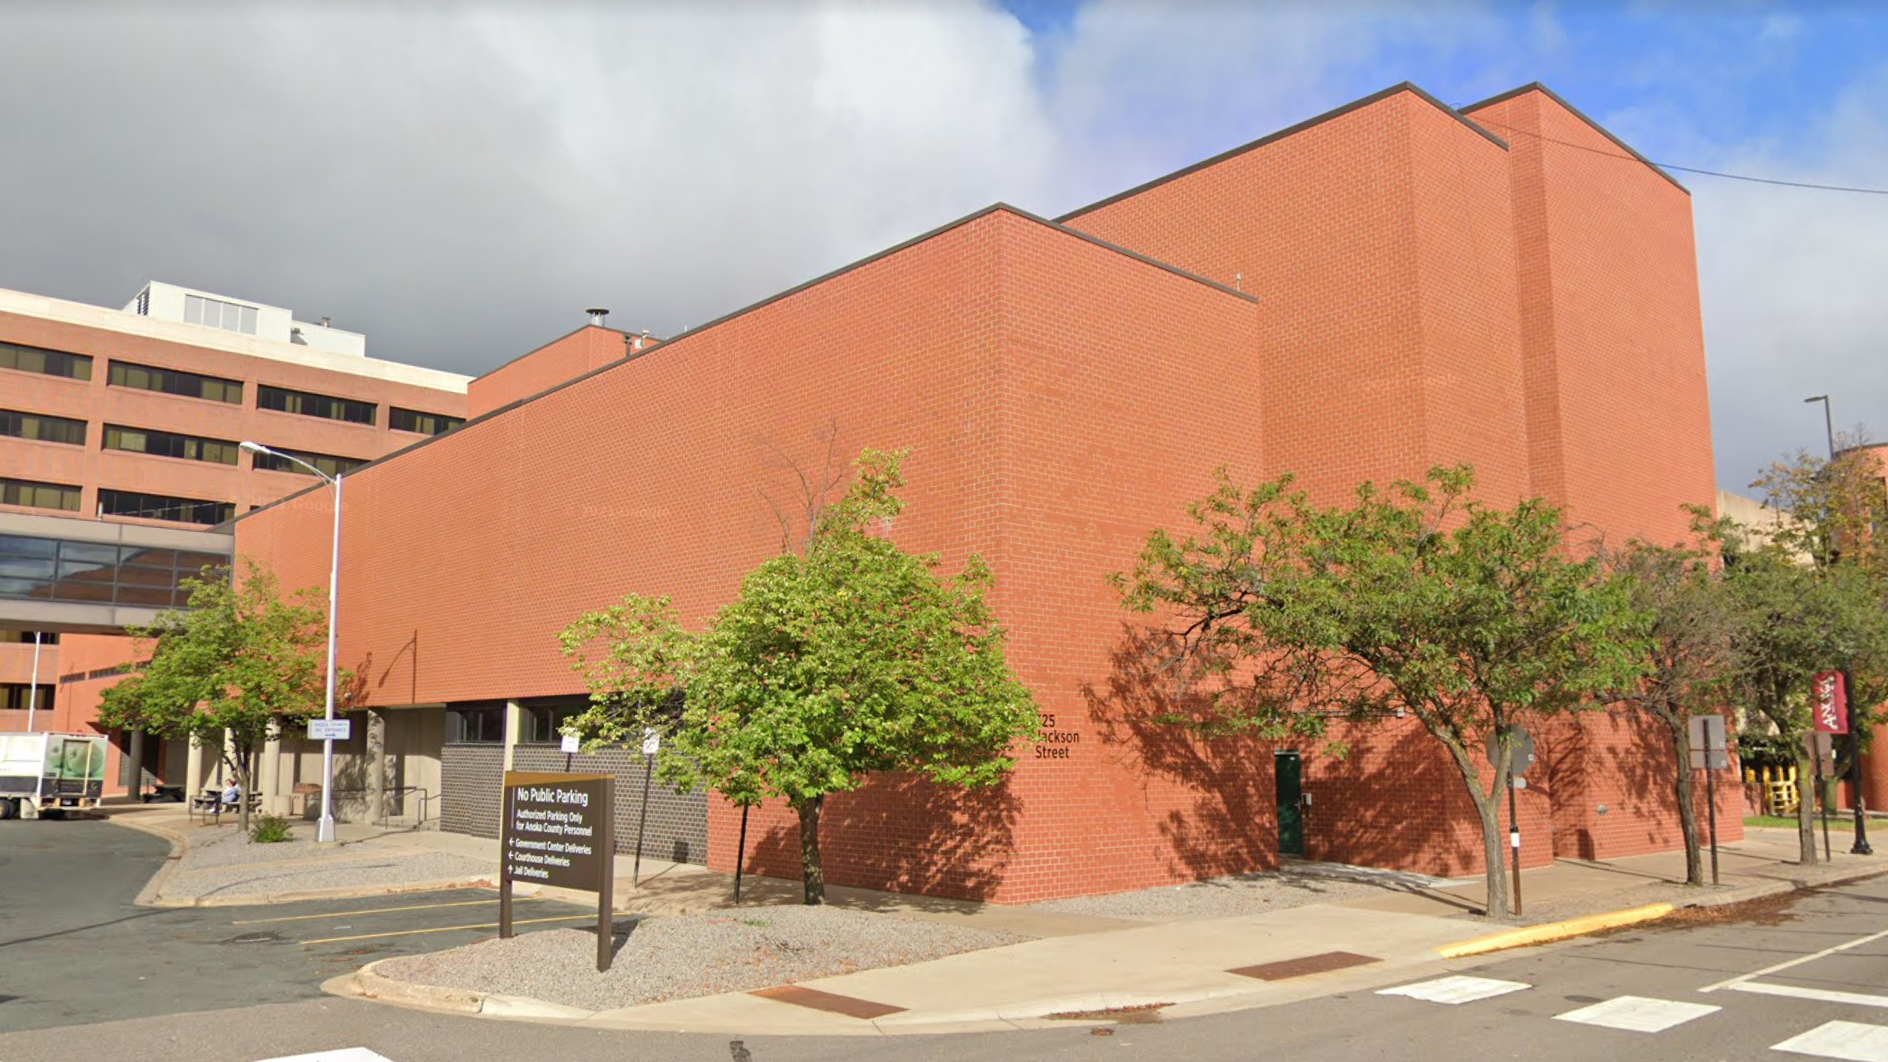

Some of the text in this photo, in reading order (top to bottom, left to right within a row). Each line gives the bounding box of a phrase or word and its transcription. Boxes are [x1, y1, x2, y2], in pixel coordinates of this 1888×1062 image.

[1037, 714, 1055, 727] 25
[1036, 745, 1069, 758] Street
[517, 787, 588, 807] No Public Parking
[517, 809, 583, 824] Authorized Parking Only
[516, 821, 593, 836] for Anoka County Personnel
[515, 838, 592, 855] Government Center Deliveries
[514, 851, 570, 867] Courthouse Deliveries
[514, 866, 549, 878] Jail Deliveries
